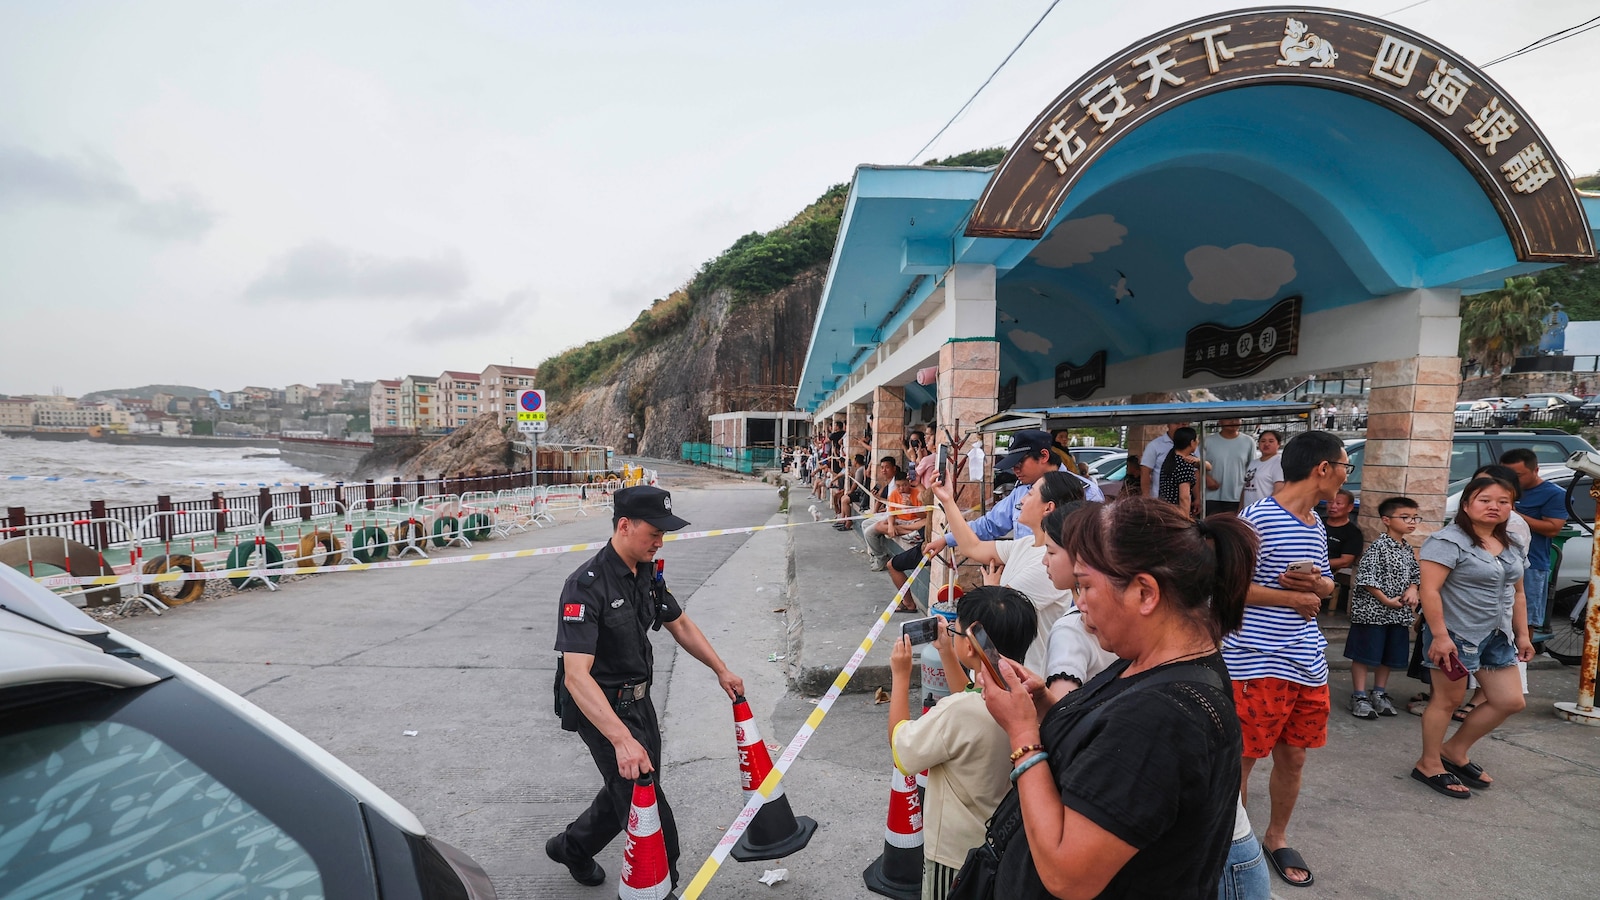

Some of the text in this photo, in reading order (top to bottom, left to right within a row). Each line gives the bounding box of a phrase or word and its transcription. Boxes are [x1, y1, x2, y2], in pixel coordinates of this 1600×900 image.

[1033, 24, 1235, 176] 法安天下
[1369, 33, 1558, 195] 四海波静
[906, 793, 923, 831] 交警
